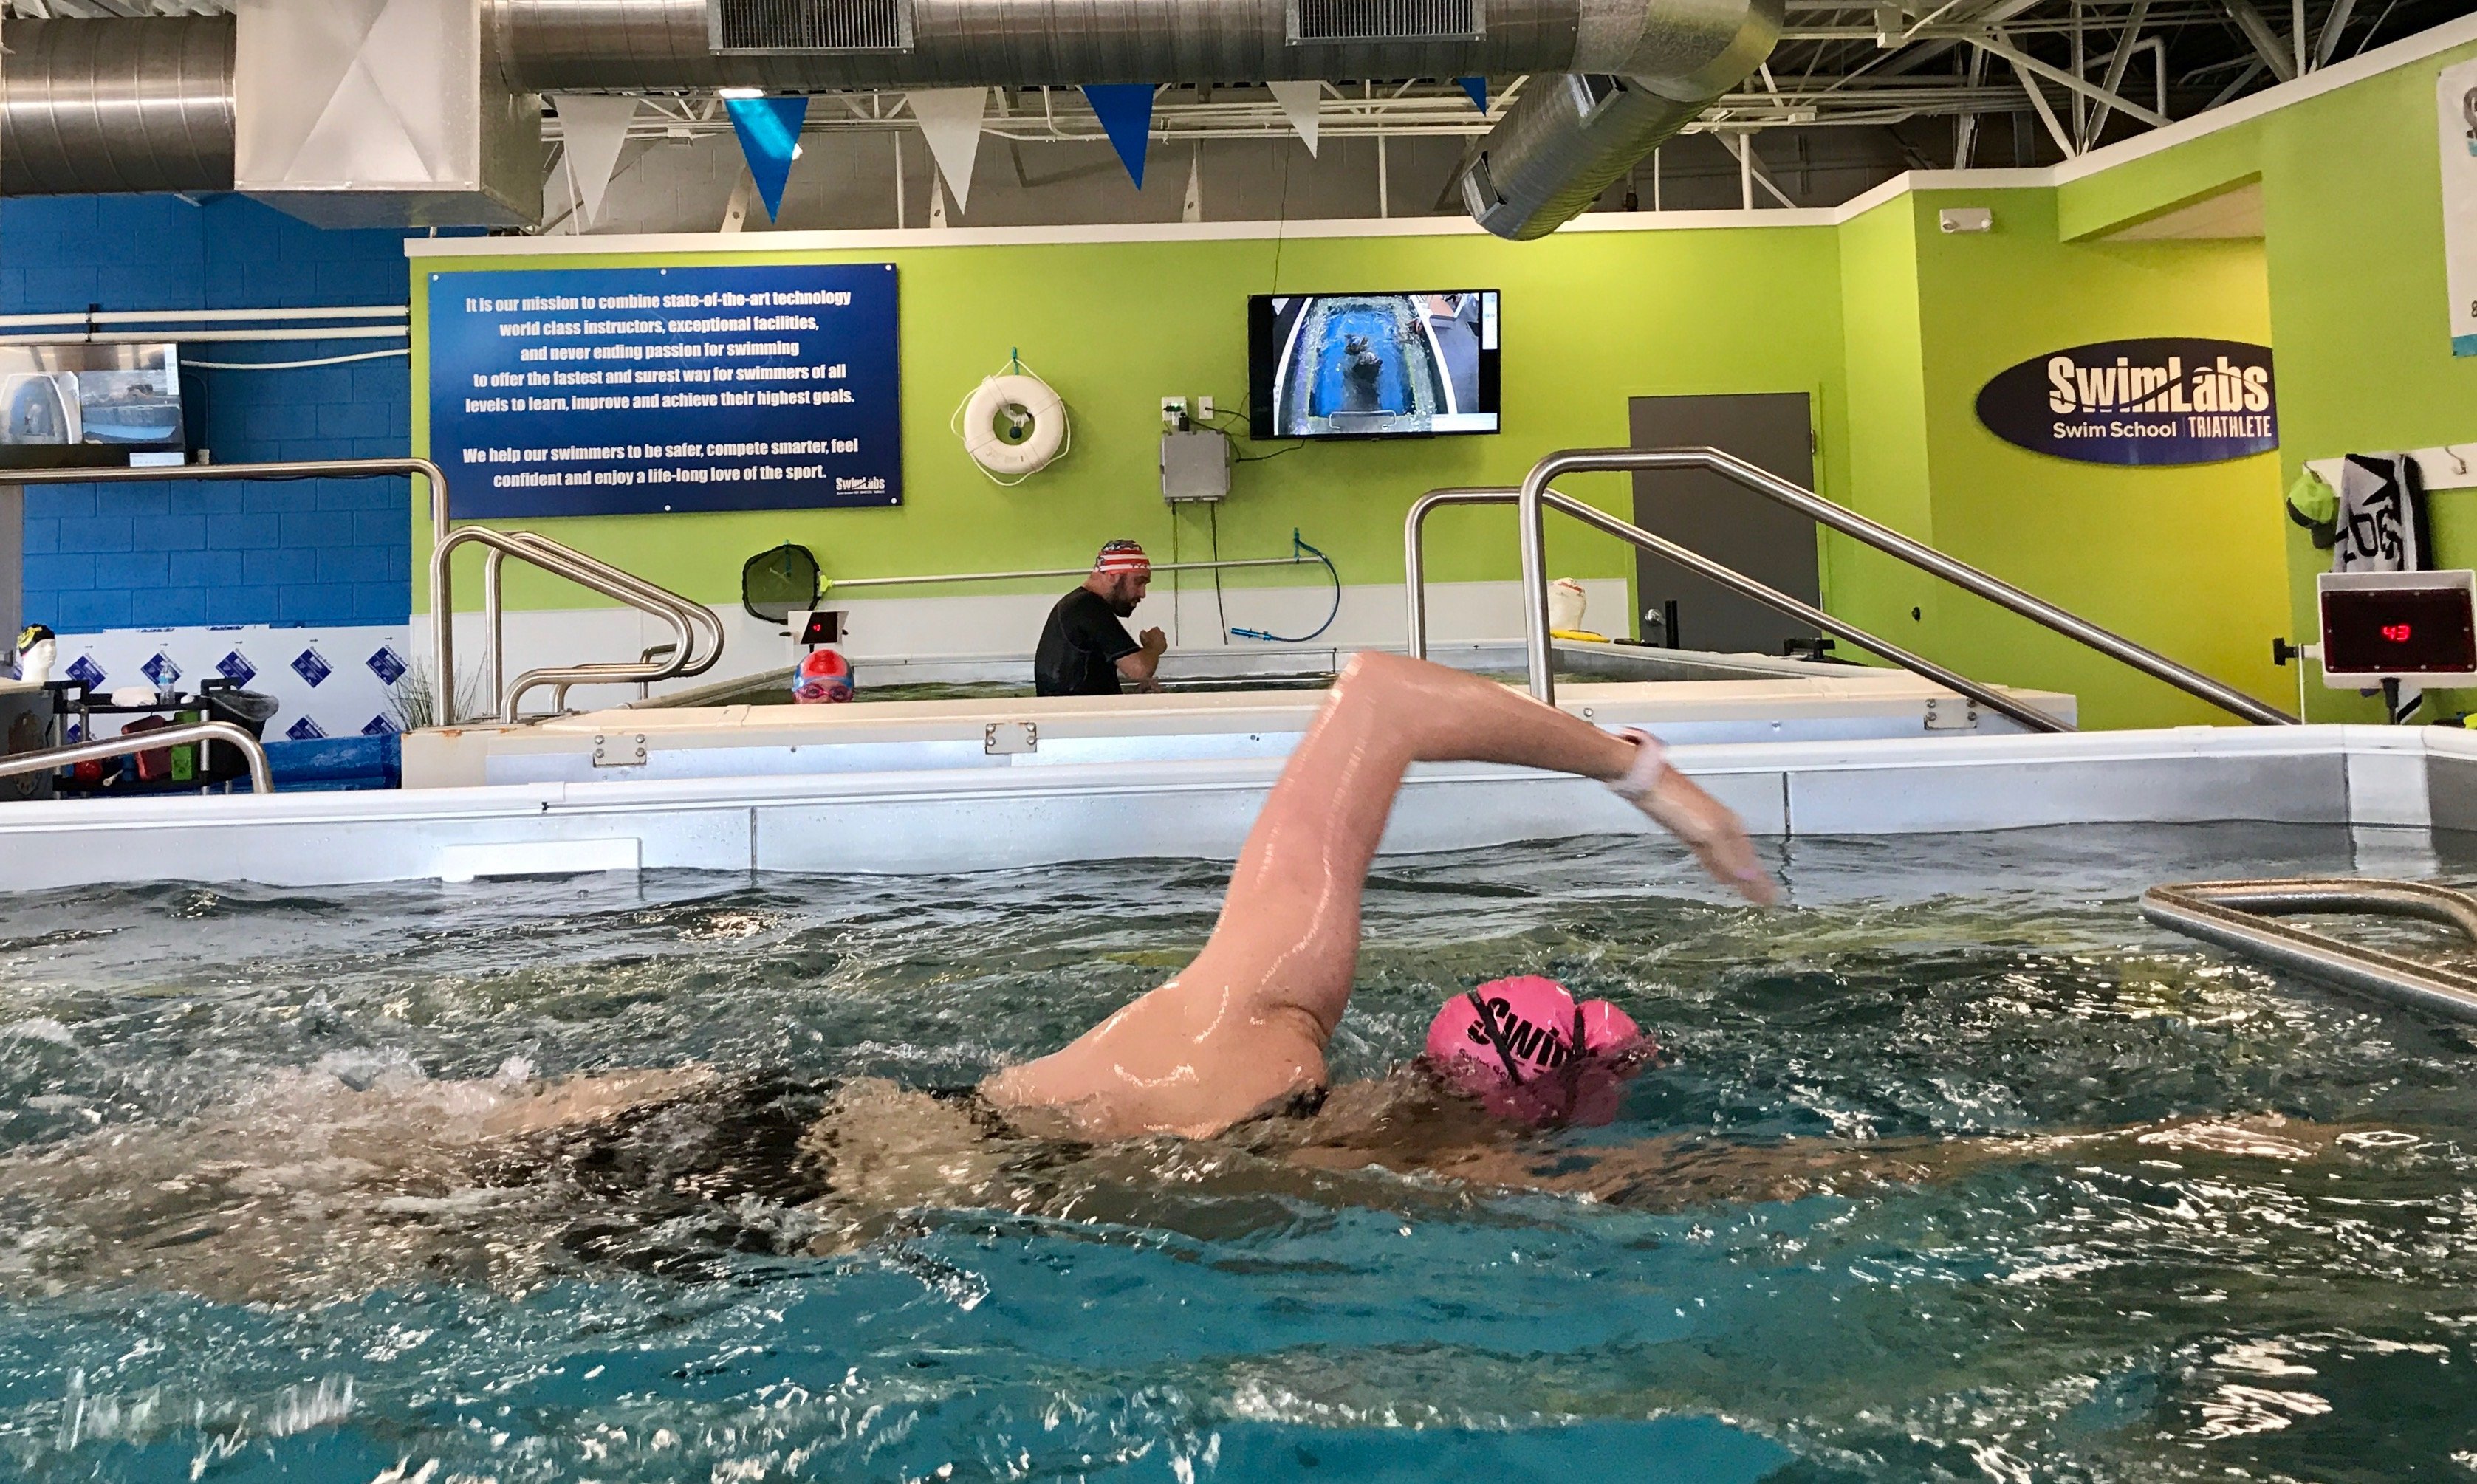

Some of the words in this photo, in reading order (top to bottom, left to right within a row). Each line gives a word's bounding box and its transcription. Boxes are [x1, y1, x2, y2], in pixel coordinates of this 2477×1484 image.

[465, 298, 478, 312] It
[479, 298, 493, 312] is
[494, 299, 520, 312] our
[521, 296, 579, 311] mission
[580, 297, 596, 309] to
[597, 294, 661, 309] combine
[662, 292, 771, 307] state-of-the-art
[772, 290, 852, 306] technology
[499, 321, 541, 337] world
[543, 321, 582, 335] class
[583, 320, 666, 334] instructors,
[668, 317, 751, 333] exceptional
[753, 315, 819, 330] facilities,
[520, 346, 548, 361] and
[549, 348, 591, 360] never
[593, 345, 643, 360] ending
[645, 343, 702, 359] passion
[703, 343, 724, 357] for
[726, 341, 800, 356] swimming
[473, 374, 488, 387] to
[490, 372, 525, 387] offer
[527, 371, 551, 385] the
[552, 371, 603, 385] fastest
[605, 369, 632, 384] and
[634, 369, 681, 383] surest
[682, 370, 711, 382] way
[713, 367, 734, 381] for
[736, 366, 809, 380] swimmers
[811, 365, 826, 379] of
[828, 364, 846, 378] all
[2048, 356, 2269, 414] SwimLabs
[465, 398, 509, 412] levels
[510, 398, 526, 411] to
[528, 397, 569, 411] learn,
[571, 396, 630, 410] improve
[632, 394, 659, 408] and
[662, 393, 719, 407] achieve
[720, 391, 755, 405] their
[756, 391, 811, 406] highest
[812, 389, 855, 405] goals.
[2052, 421, 2106, 439] Swim
[2110, 420, 2177, 439] School
[2187, 415, 2272, 439] TRIATHLETE
[462, 449, 487, 463] We
[488, 448, 521, 463] help
[523, 449, 549, 461] our
[550, 446, 626, 461] swimmers
[626, 445, 643, 458] to
[644, 444, 663, 458] be
[665, 443, 705, 458] safer,
[705, 442, 769, 457] compete
[770, 441, 829, 454] smarter,
[830, 438, 859, 453] feel
[493, 472, 563, 487] confident
[564, 471, 592, 485] and
[594, 470, 634, 485] enjoy
[636, 472, 645, 483] a
[648, 468, 708, 483] life-long
[710, 467, 741, 481] love
[743, 466, 758, 480] of
[759, 466, 784, 479] the
[785, 465, 827, 480] sport.
[835, 476, 885, 491] SwimLabs
[2382, 625, 2411, 642] 43
